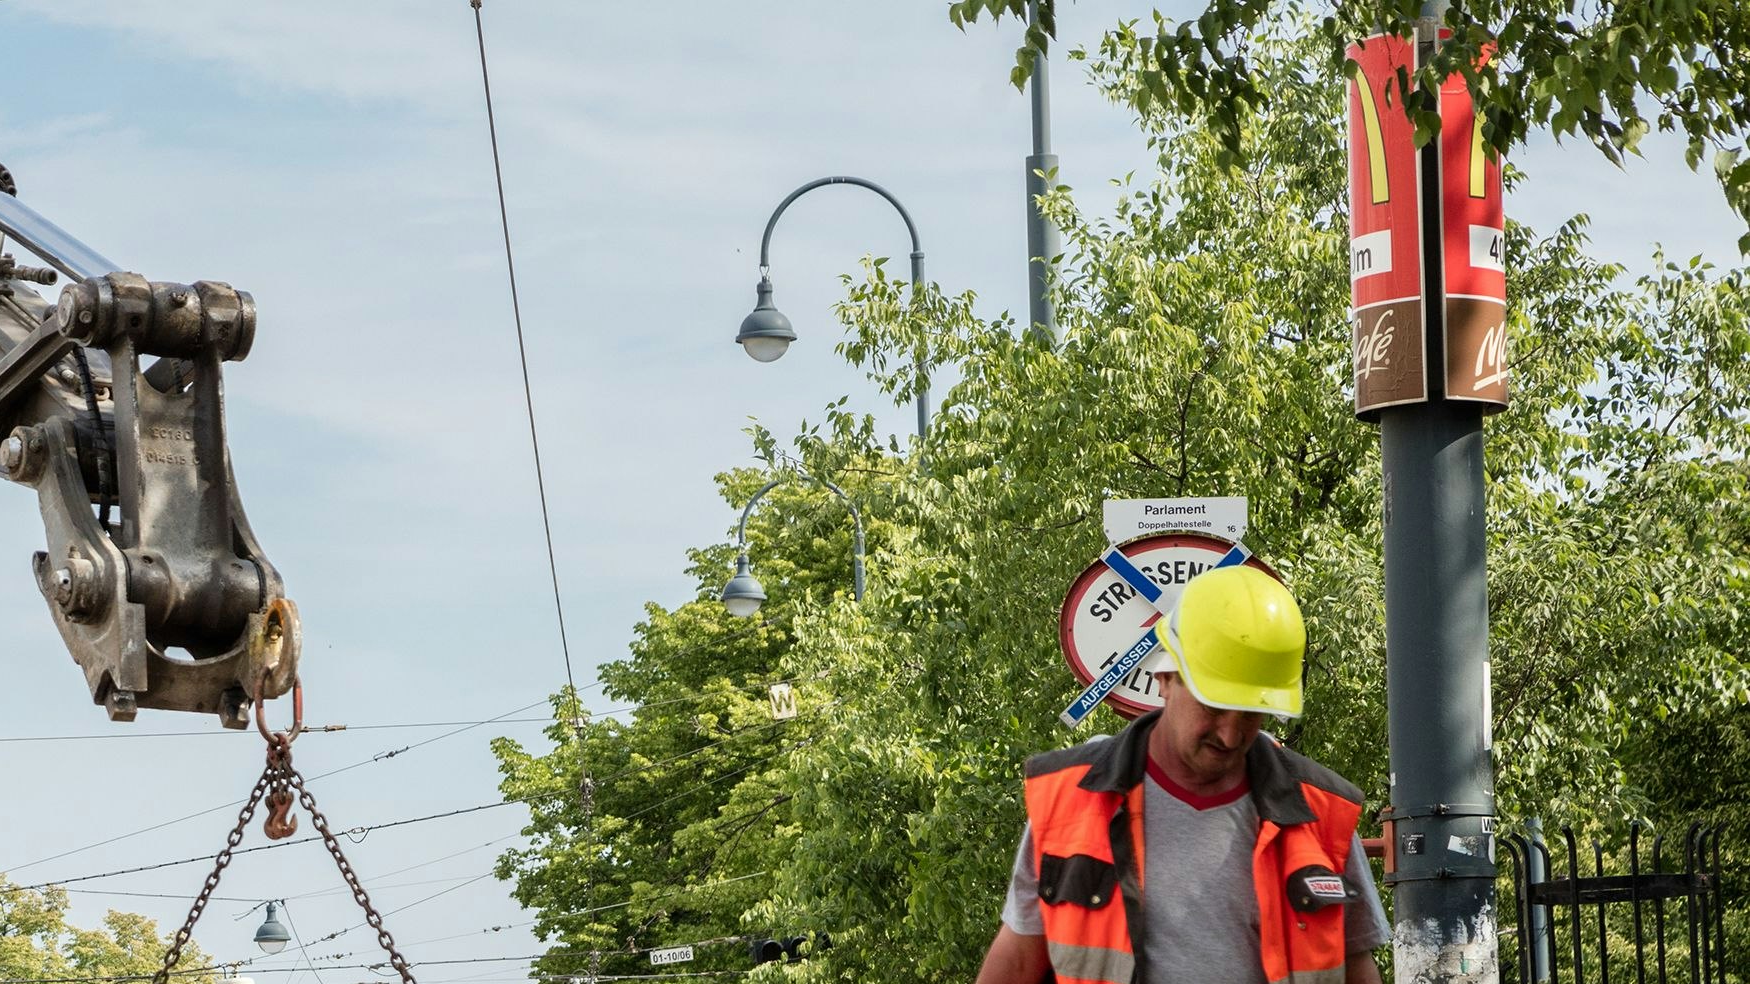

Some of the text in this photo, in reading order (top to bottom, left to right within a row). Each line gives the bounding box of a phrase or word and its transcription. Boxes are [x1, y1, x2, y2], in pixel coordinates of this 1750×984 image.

[1490, 234, 1505, 265] 40
[1144, 504, 1207, 515] Parlament
[1138, 521, 1212, 529] Doppelhaltestelle
[1081, 637, 1154, 710] AUFGELASSEN
[771, 691, 792, 712] W
[652, 950, 691, 963] 01-10/06
